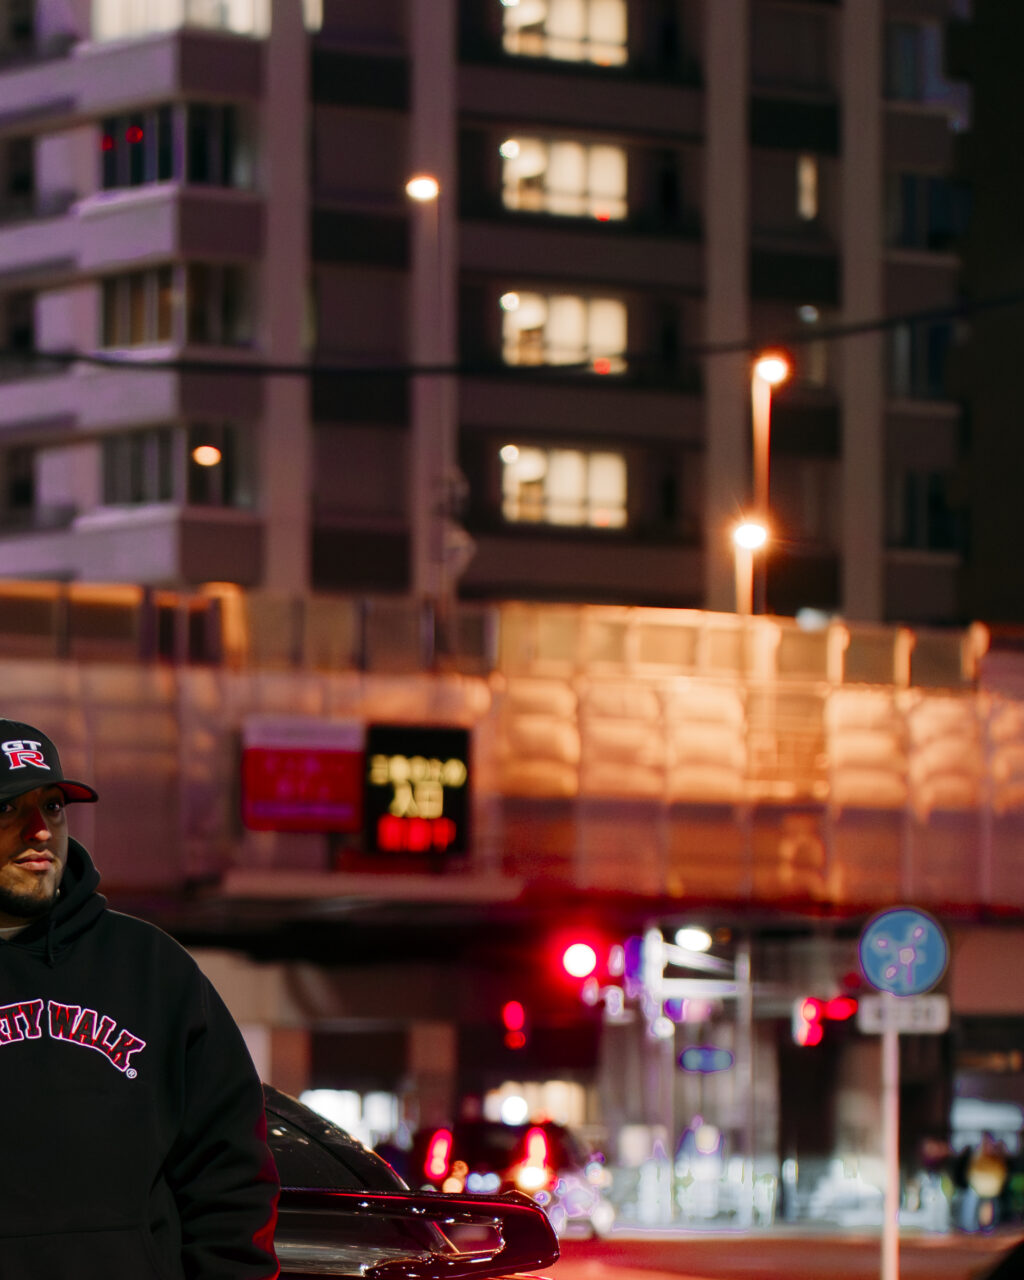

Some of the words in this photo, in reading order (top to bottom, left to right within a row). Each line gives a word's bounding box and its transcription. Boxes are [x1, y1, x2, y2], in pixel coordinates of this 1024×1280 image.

[1, 740, 42, 751] GT
[4, 750, 51, 770] R
[48, 1000, 146, 1072] WALK
